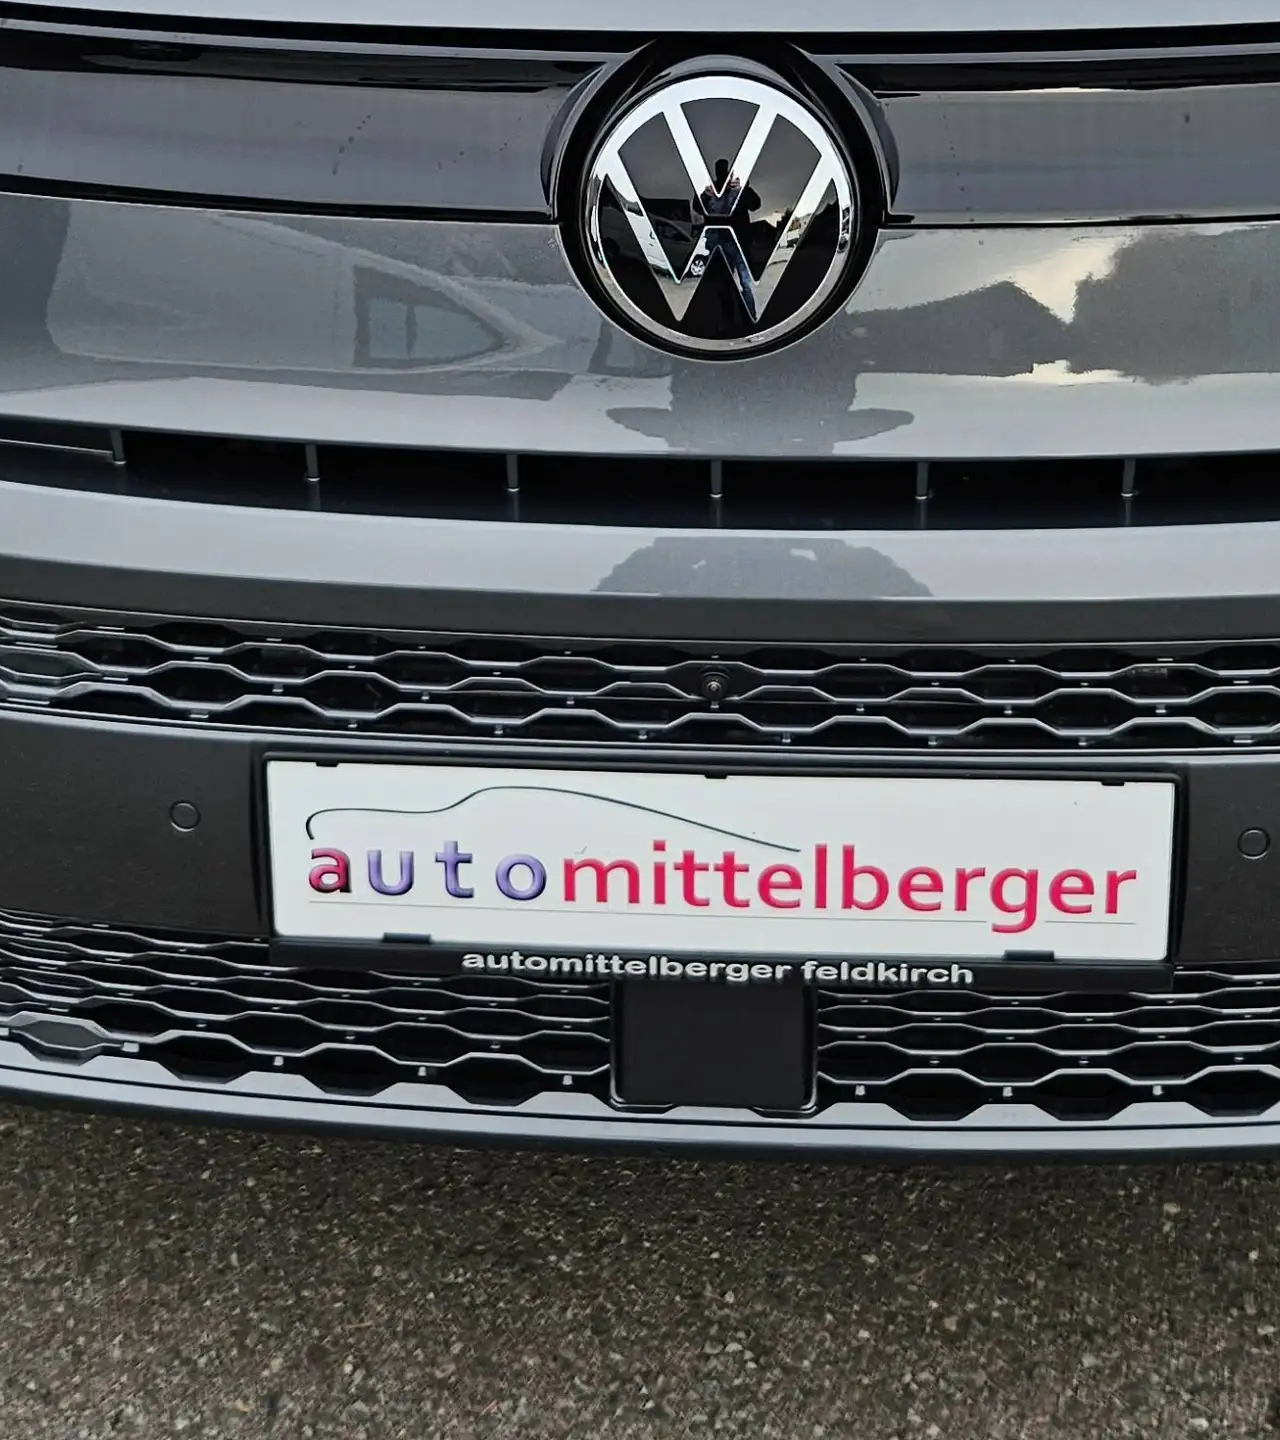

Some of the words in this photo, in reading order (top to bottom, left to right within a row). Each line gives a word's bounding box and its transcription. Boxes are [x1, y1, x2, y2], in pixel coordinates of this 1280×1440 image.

[308, 839, 1137, 934] automittelberger
[461, 950, 793, 983] automittelberger
[800, 960, 975, 985] feldkirch
